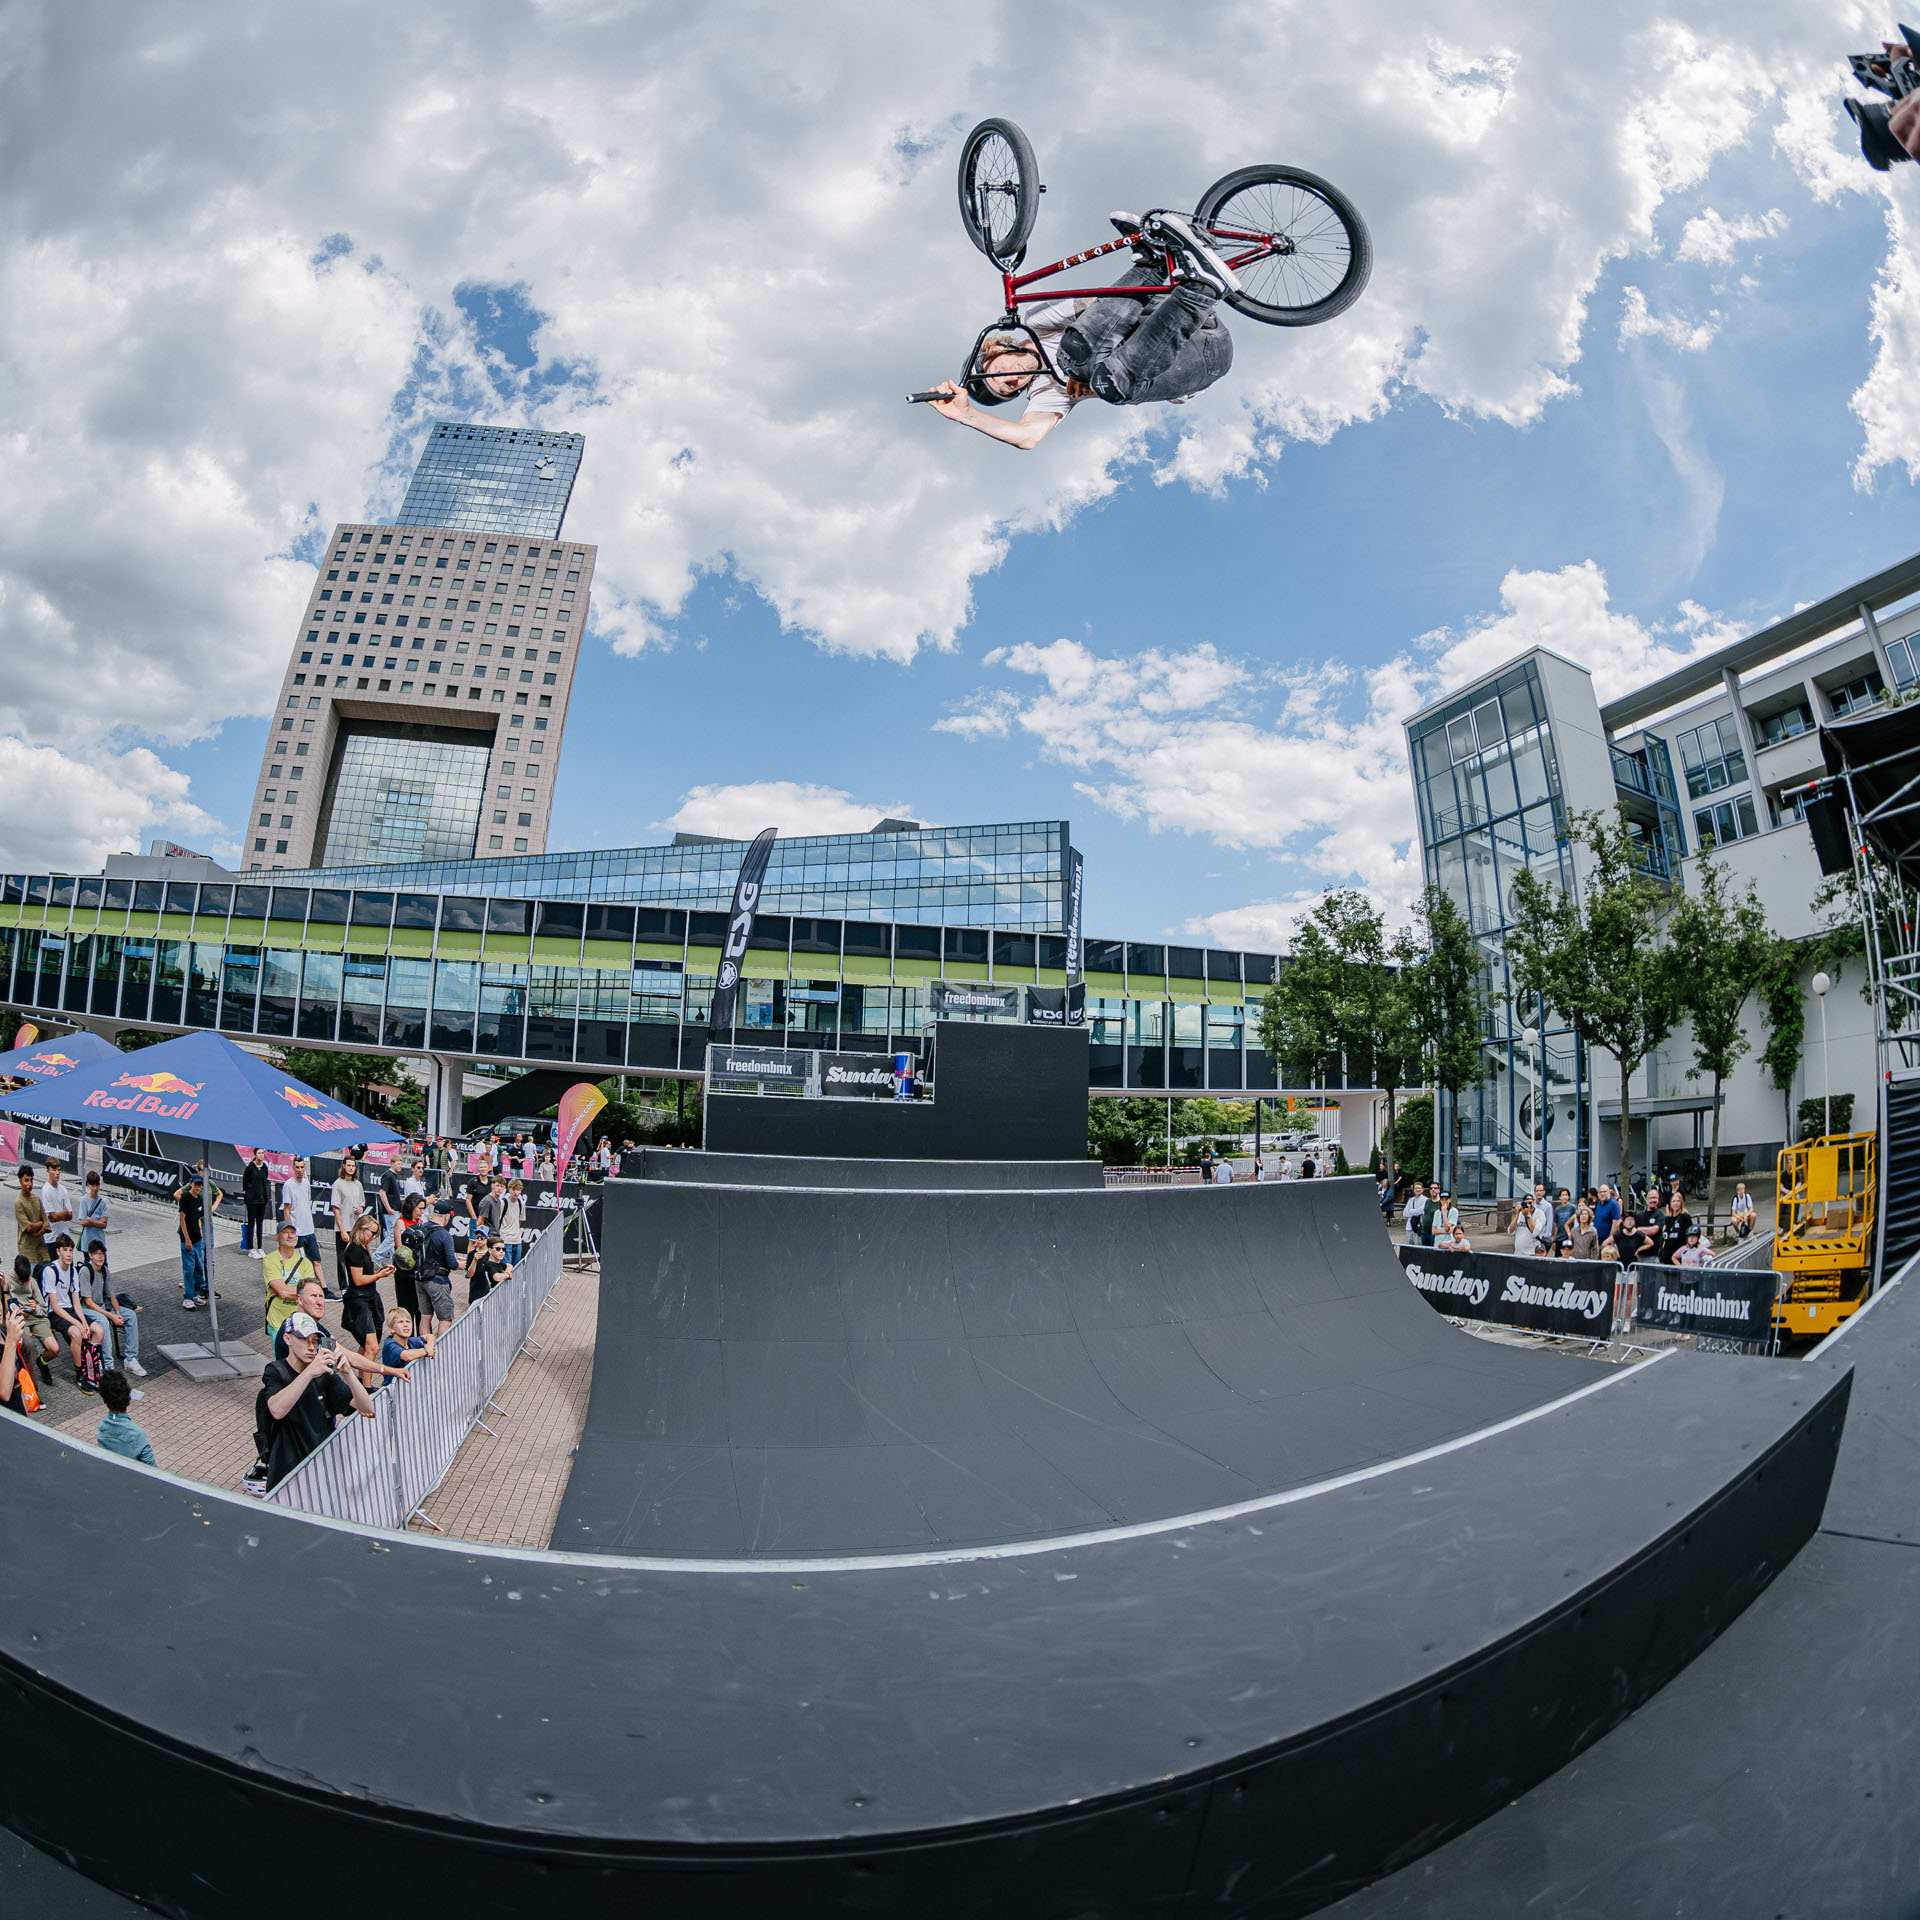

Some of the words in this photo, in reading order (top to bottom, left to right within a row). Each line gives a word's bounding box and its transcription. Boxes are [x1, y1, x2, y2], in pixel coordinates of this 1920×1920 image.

[725, 882, 758, 958] TSG
[944, 991, 1006, 1007] freedombmx
[15, 1061, 46, 1073] Red
[726, 1058, 793, 1075] freedombmx
[82, 1089, 143, 1110] Red
[136, 1095, 200, 1120] Bull
[104, 1160, 178, 1187] AMFLOW
[1405, 1263, 1490, 1305] Sunday
[1500, 1274, 1608, 1320] Sunday
[1657, 1286, 1751, 1321] freedombmx
